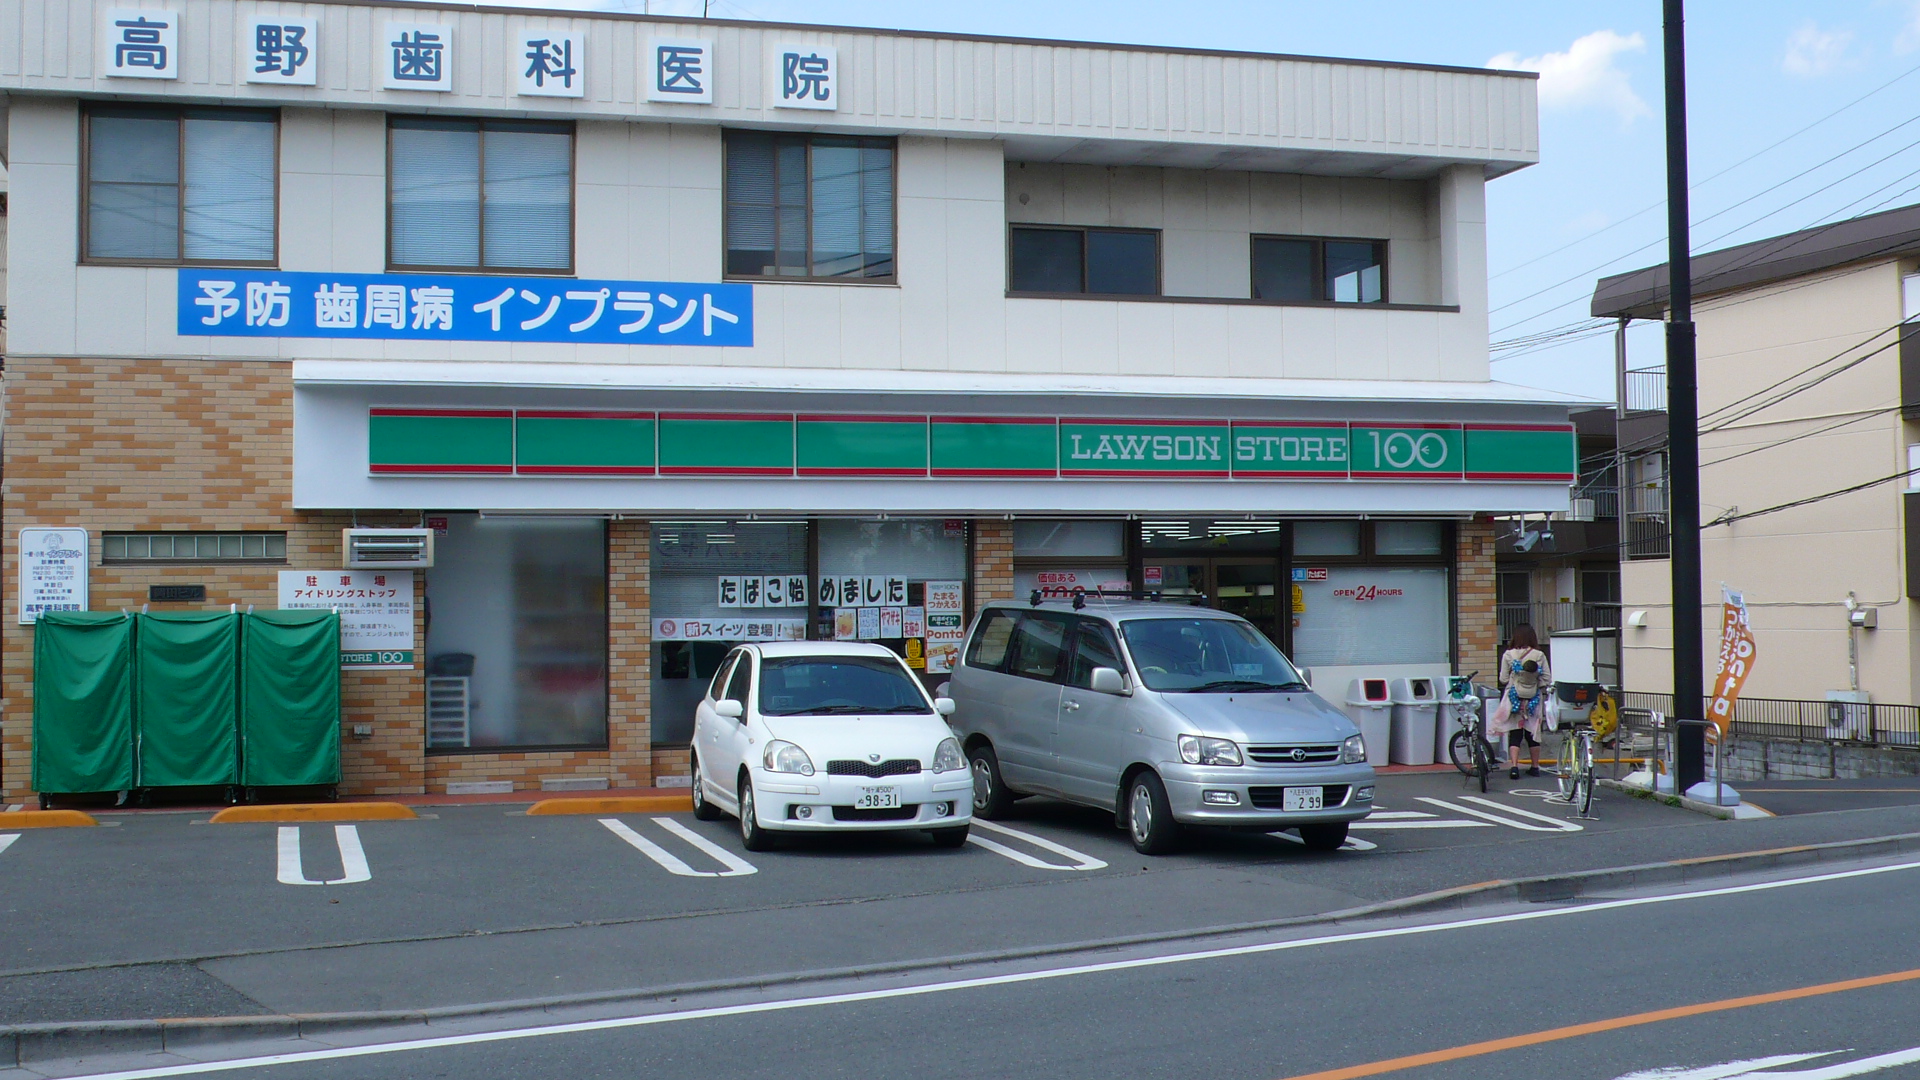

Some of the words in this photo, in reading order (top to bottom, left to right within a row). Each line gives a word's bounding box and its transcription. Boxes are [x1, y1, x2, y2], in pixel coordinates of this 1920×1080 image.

[114, 16, 830, 101] 高野歯科医院
[195, 280, 291, 327] 予防
[314, 282, 454, 331] 歯周病
[473, 287, 739, 337] インプラント
[1071, 434, 1222, 461] LAWSON
[1236, 436, 1347, 462] STORE
[1368, 431, 1448, 469] 100
[305, 575, 386, 587] 駐車場
[1038, 573, 1076, 583] 価値ある
[1308, 571, 1326, 579] たばこ
[294, 589, 397, 598] アイドリングストップ
[1333, 589, 1355, 597] OPEN
[1355, 585, 1377, 601] 24
[25, 603, 81, 612] 高野歯科医院
[926, 629, 964, 640] Ponta
[377, 651, 403, 663] 100
[865, 793, 897, 807] 98-31
